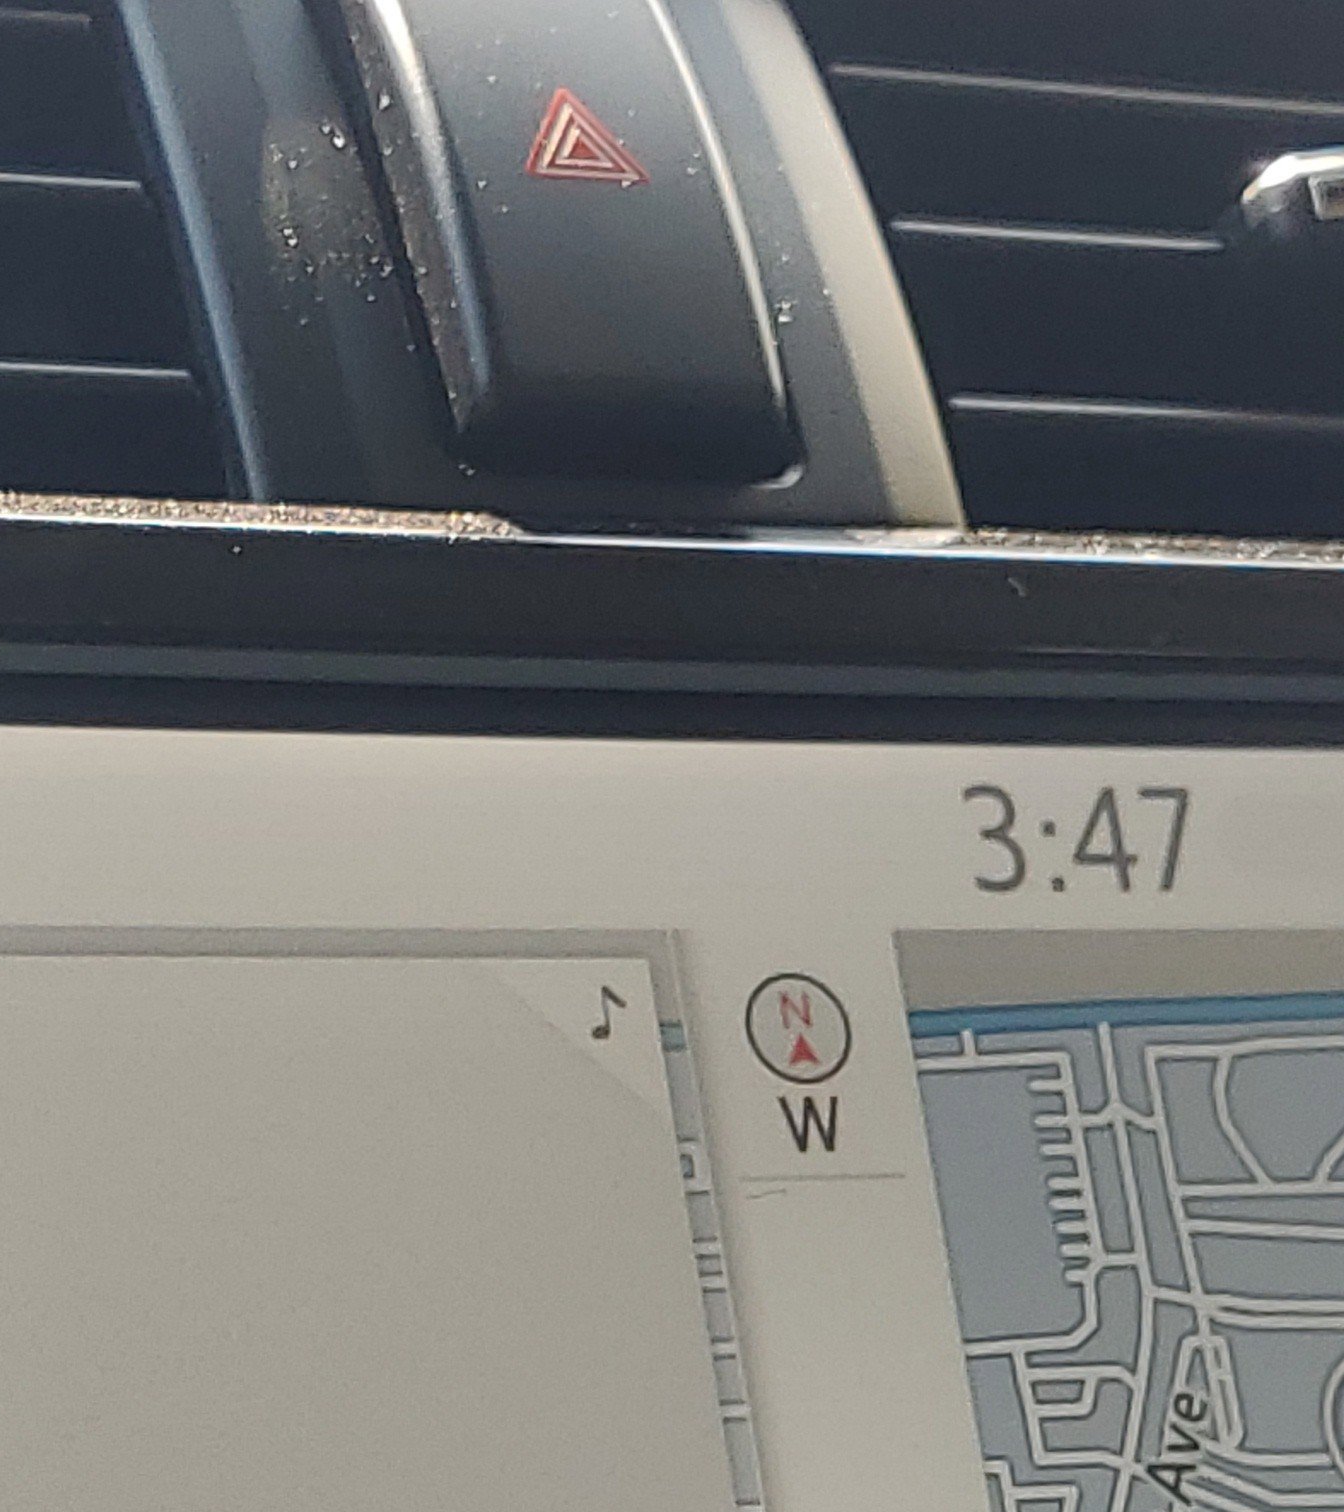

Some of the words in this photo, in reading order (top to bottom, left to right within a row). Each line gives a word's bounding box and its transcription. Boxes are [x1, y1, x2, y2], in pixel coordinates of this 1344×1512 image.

[961, 784, 1191, 893] 3:47
[777, 989, 815, 1030] N
[776, 1095, 839, 1153] W
[1145, 1391, 1210, 1508] Ave
